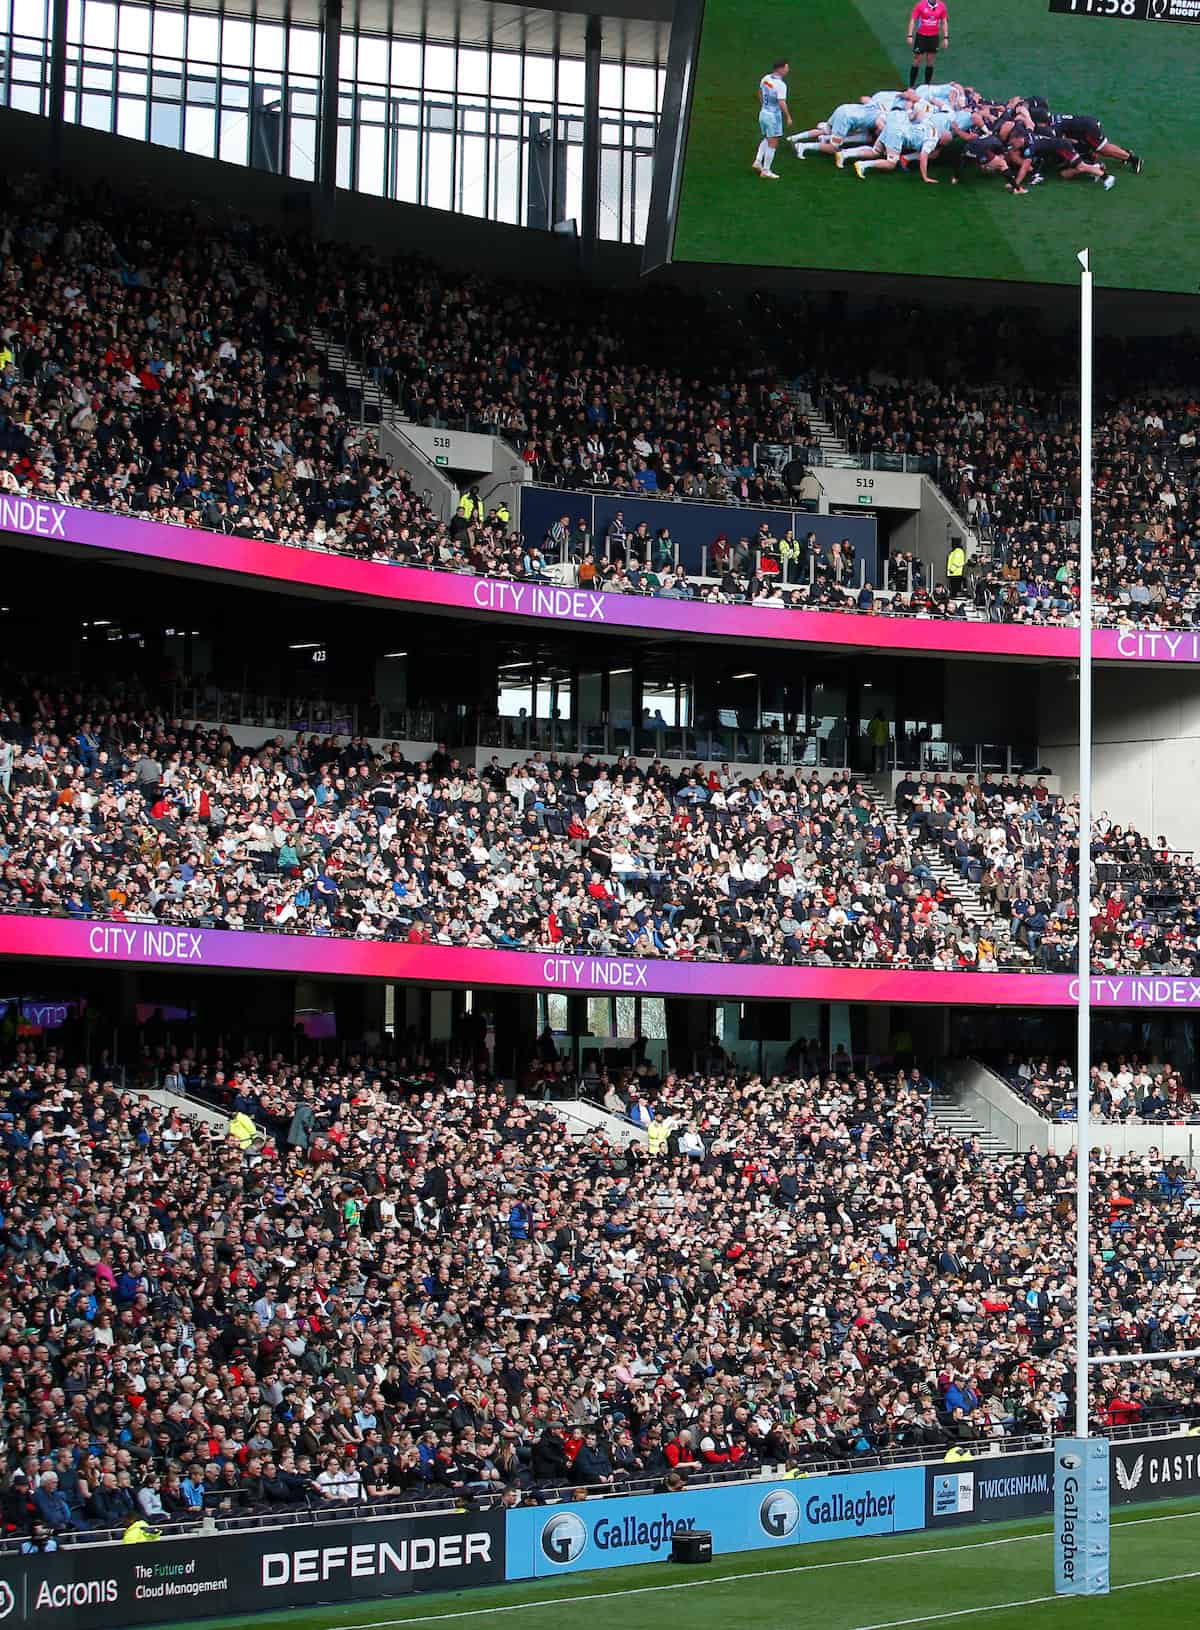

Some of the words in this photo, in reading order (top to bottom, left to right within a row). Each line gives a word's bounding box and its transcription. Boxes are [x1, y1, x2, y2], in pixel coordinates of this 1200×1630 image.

[1170, 8, 1200, 17] RUGBY
[433, 437, 450, 447] 518
[856, 479, 874, 488] 519
[473, 581, 525, 610] CITY
[532, 588, 605, 619] INDEX
[1117, 634, 1182, 657] CITY
[89, 927, 136, 954] CITY
[143, 931, 202, 958] INDEX
[543, 958, 584, 984] CITY
[591, 961, 648, 987] INDEX
[1068, 981, 1122, 1001] CTY
[978, 1473, 1050, 1500] TWICKENHAM,
[806, 1491, 895, 1525] Gallagher
[593, 1513, 695, 1552] Gallagher
[1061, 1476, 1079, 1583] Gallagher
[135, 1565, 151, 1579] The
[153, 1562, 183, 1577] Future
[185, 1560, 195, 1574] of
[261, 1532, 493, 1587] DEFENDER
[36, 1579, 118, 1609] Acronis
[135, 1583, 163, 1599] Cloud
[164, 1578, 228, 1597] Management
